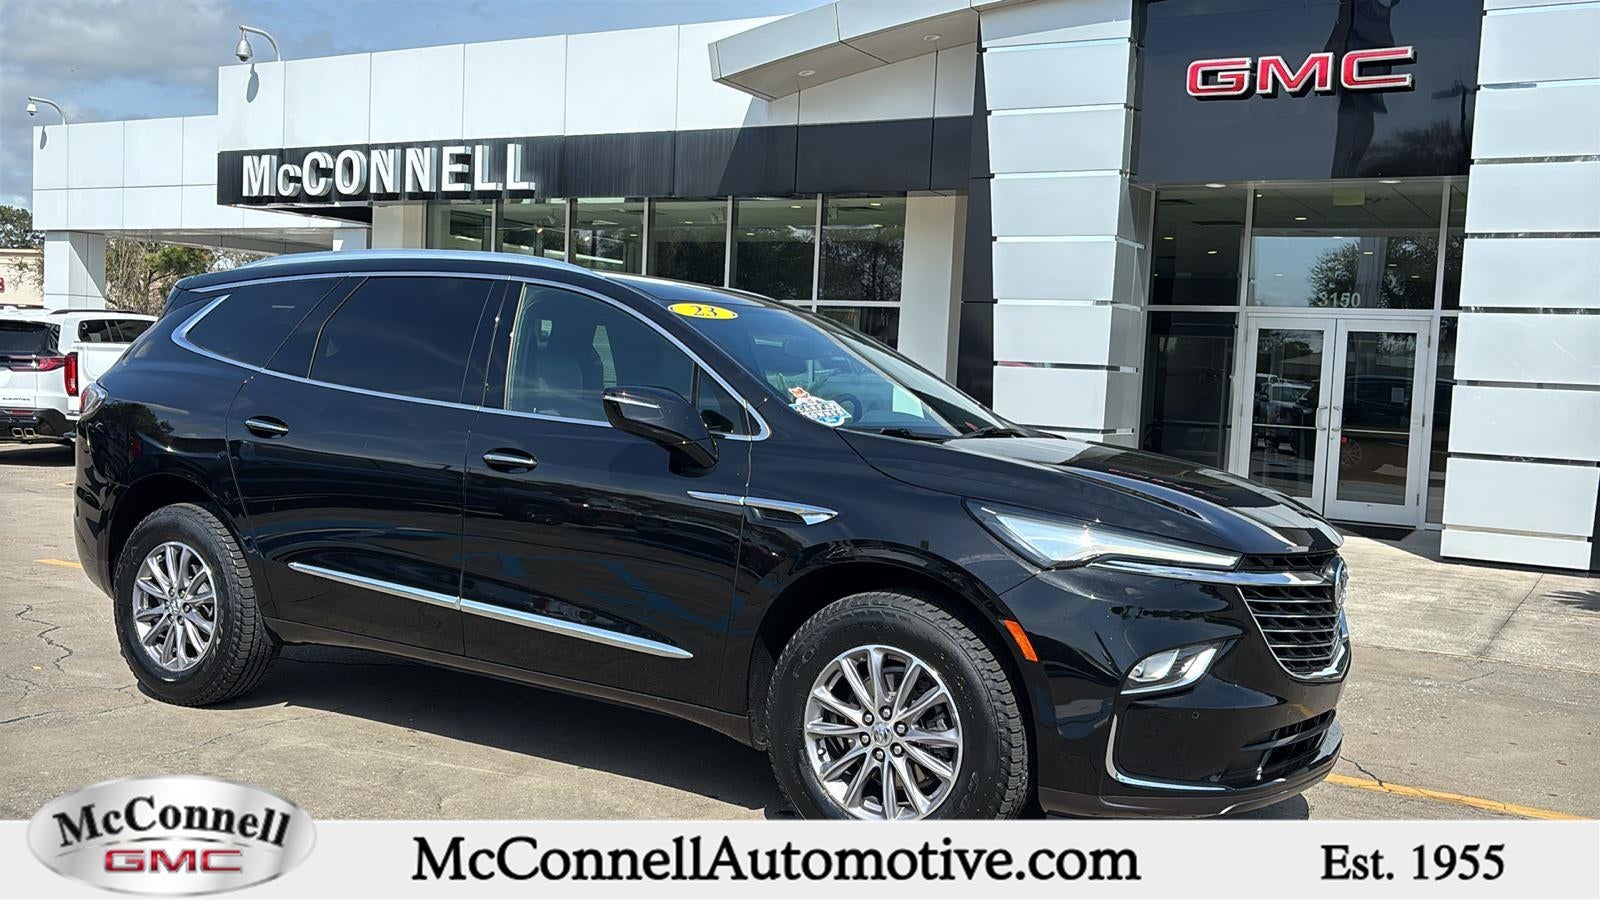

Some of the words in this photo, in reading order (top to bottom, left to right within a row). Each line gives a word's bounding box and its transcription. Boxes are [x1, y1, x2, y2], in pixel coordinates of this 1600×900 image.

[1186, 46, 1414, 97] GMC
[242, 143, 536, 197] McCONNELL
[690, 305, 717, 317] 23
[1317, 291, 1361, 308] 3150
